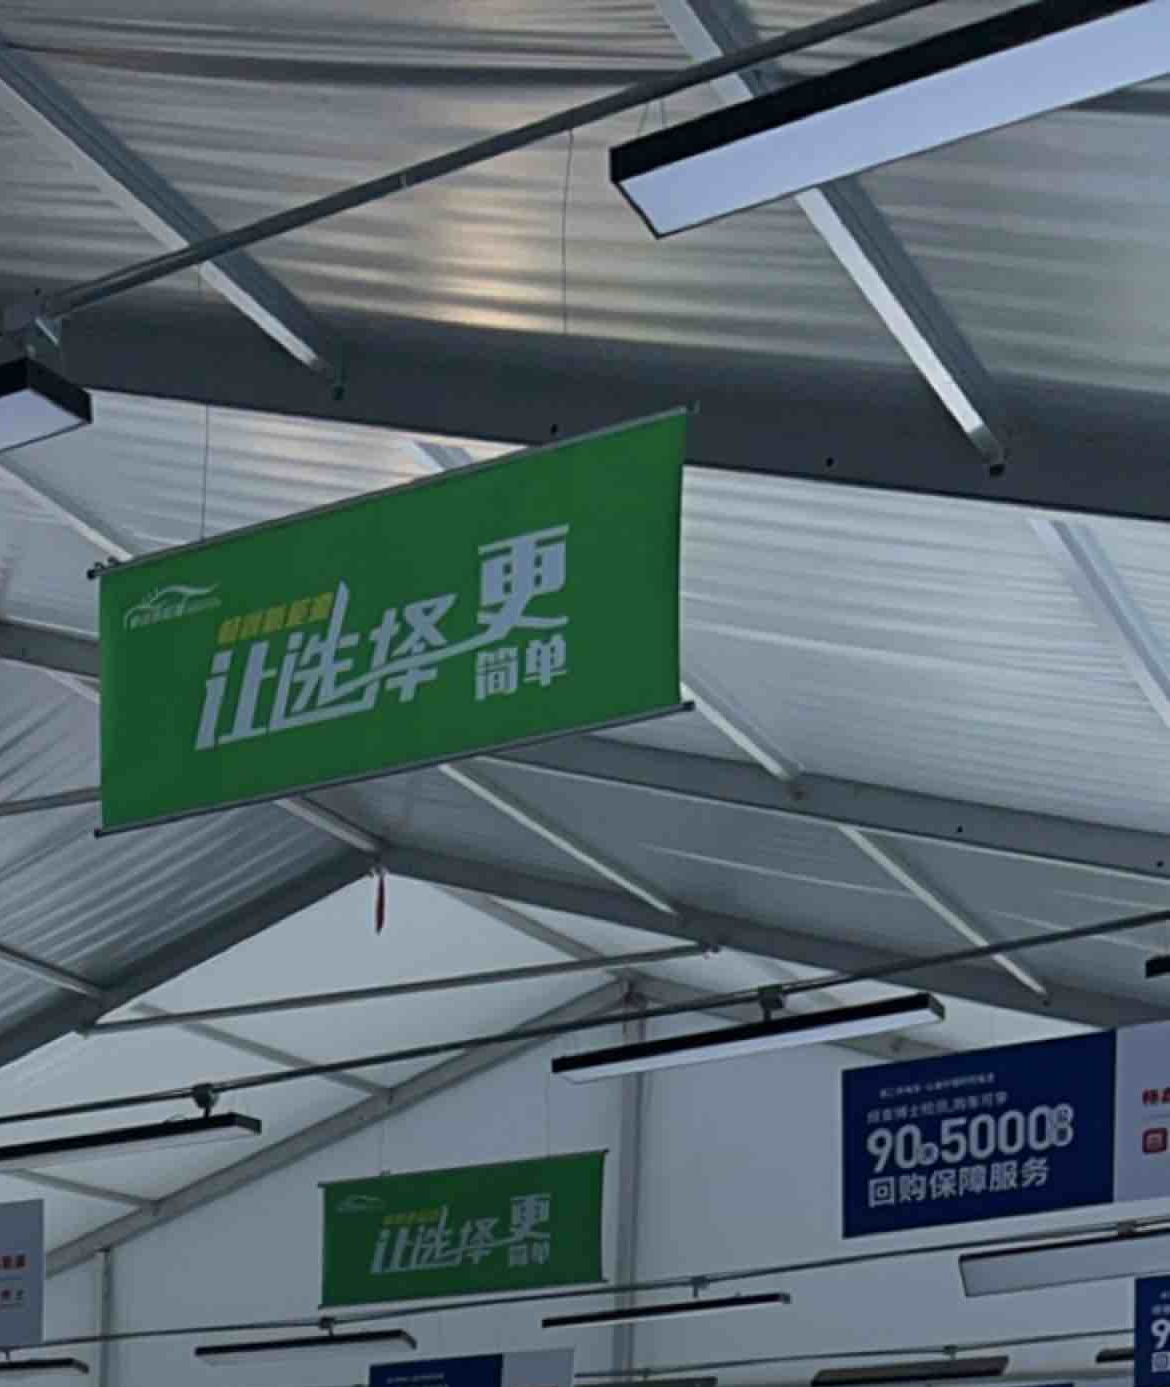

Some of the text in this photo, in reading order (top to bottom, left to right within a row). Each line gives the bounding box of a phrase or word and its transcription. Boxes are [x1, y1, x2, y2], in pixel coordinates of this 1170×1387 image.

[475, 634, 568, 699] 简单
[868, 1157, 1049, 1208] 回购保障服务
